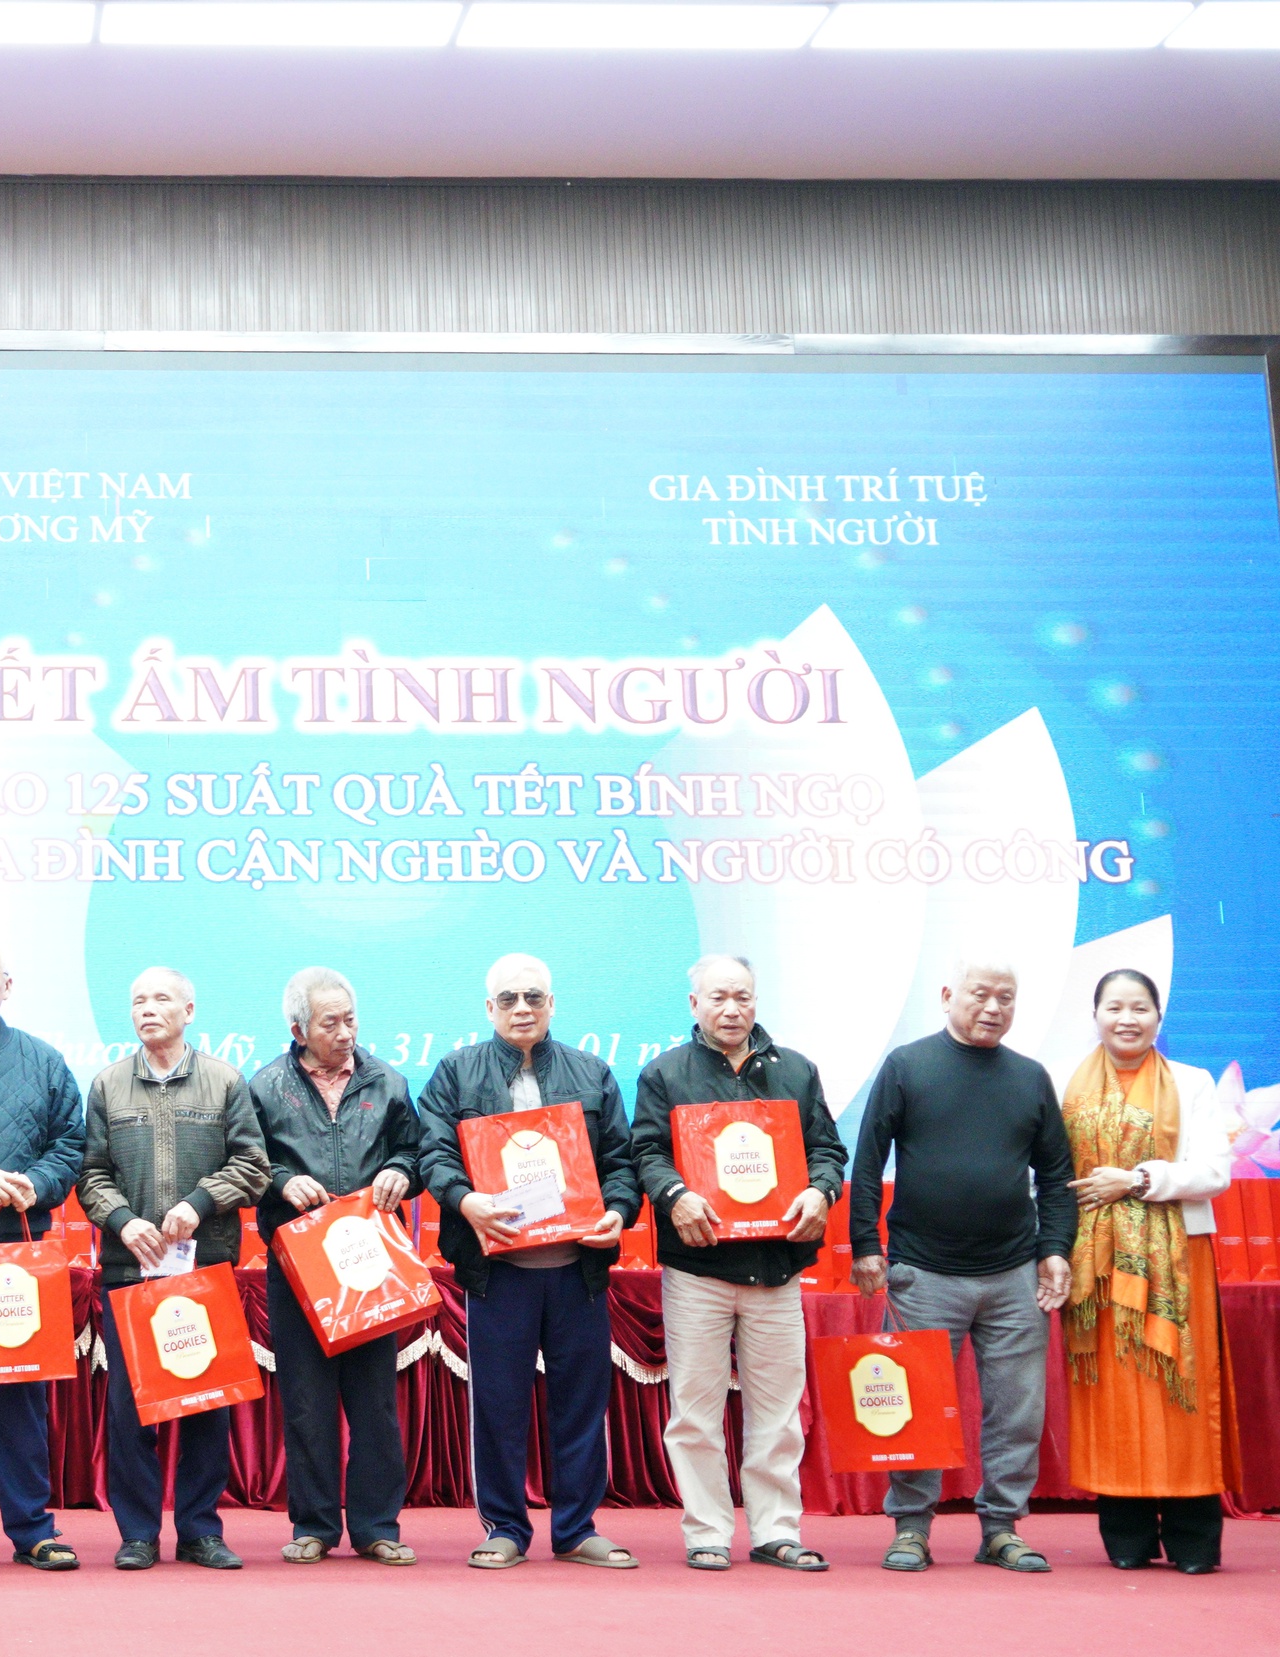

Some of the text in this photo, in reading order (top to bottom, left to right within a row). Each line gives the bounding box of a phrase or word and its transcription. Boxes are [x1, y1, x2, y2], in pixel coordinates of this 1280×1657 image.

[99, 471, 193, 500] NAM
[648, 467, 988, 507] GIA ĐÌNH TRÍ TUỆ
[90, 509, 154, 543] MỸ
[702, 510, 940, 545] TÌNH NGƯỜI
[121, 648, 268, 723] ẤM
[291, 649, 520, 724] TÌNH
[540, 649, 849, 725] NGƯỜI
[64, 772, 150, 817] 125
[166, 761, 321, 817] SUẤT
[332, 763, 463, 826] QUÀ
[474, 761, 584, 817] TẾT
[594, 762, 743, 818] BÍNH
[753, 773, 884, 826] NGỌ
[32, 827, 184, 882] ĐÌNH
[195, 828, 323, 890] CẬN
[334, 829, 547, 884] NGHÈO
[556, 829, 649, 883] VÀ
[657, 829, 858, 884] NGƯỜI
[866, 827, 951, 884] CÓ
[963, 828, 1135, 884] CÔNG
[388, 1032, 434, 1066] 31
[578, 1032, 620, 1066] 01
[517, 1158, 547, 1170] BUTTER
[730, 1152, 760, 1160] BUTTER
[513, 1168, 556, 1184] COOKIES
[723, 1163, 769, 1175] COOKIES
[340, 1239, 369, 1255] BUTER
[167, 1324, 197, 1338] BUTTER
[163, 1334, 208, 1353] COOKIES
[865, 1384, 895, 1393] BUTTER
[860, 1396, 904, 1407] COOKIES
